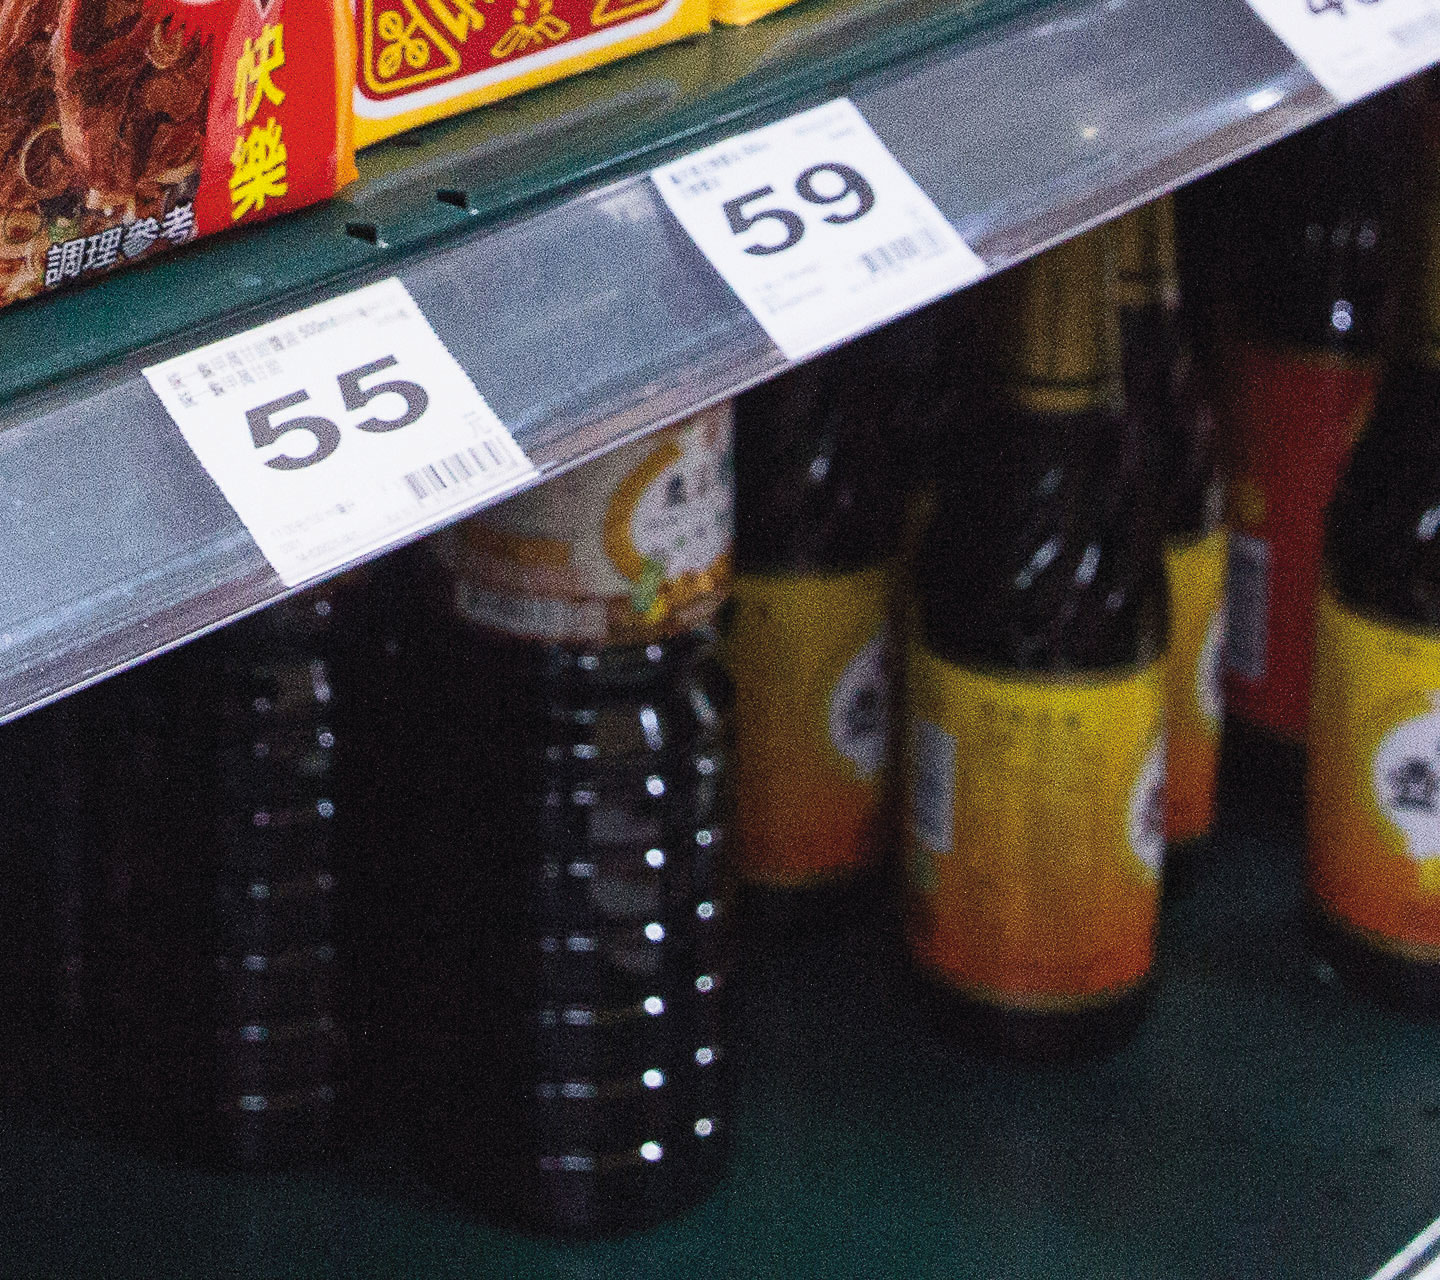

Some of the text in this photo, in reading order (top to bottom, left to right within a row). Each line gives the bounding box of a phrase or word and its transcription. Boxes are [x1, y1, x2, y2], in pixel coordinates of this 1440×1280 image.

[228, 21, 288, 222] 快樂
[721, 161, 877, 257] 59
[243, 353, 430, 471] 55
